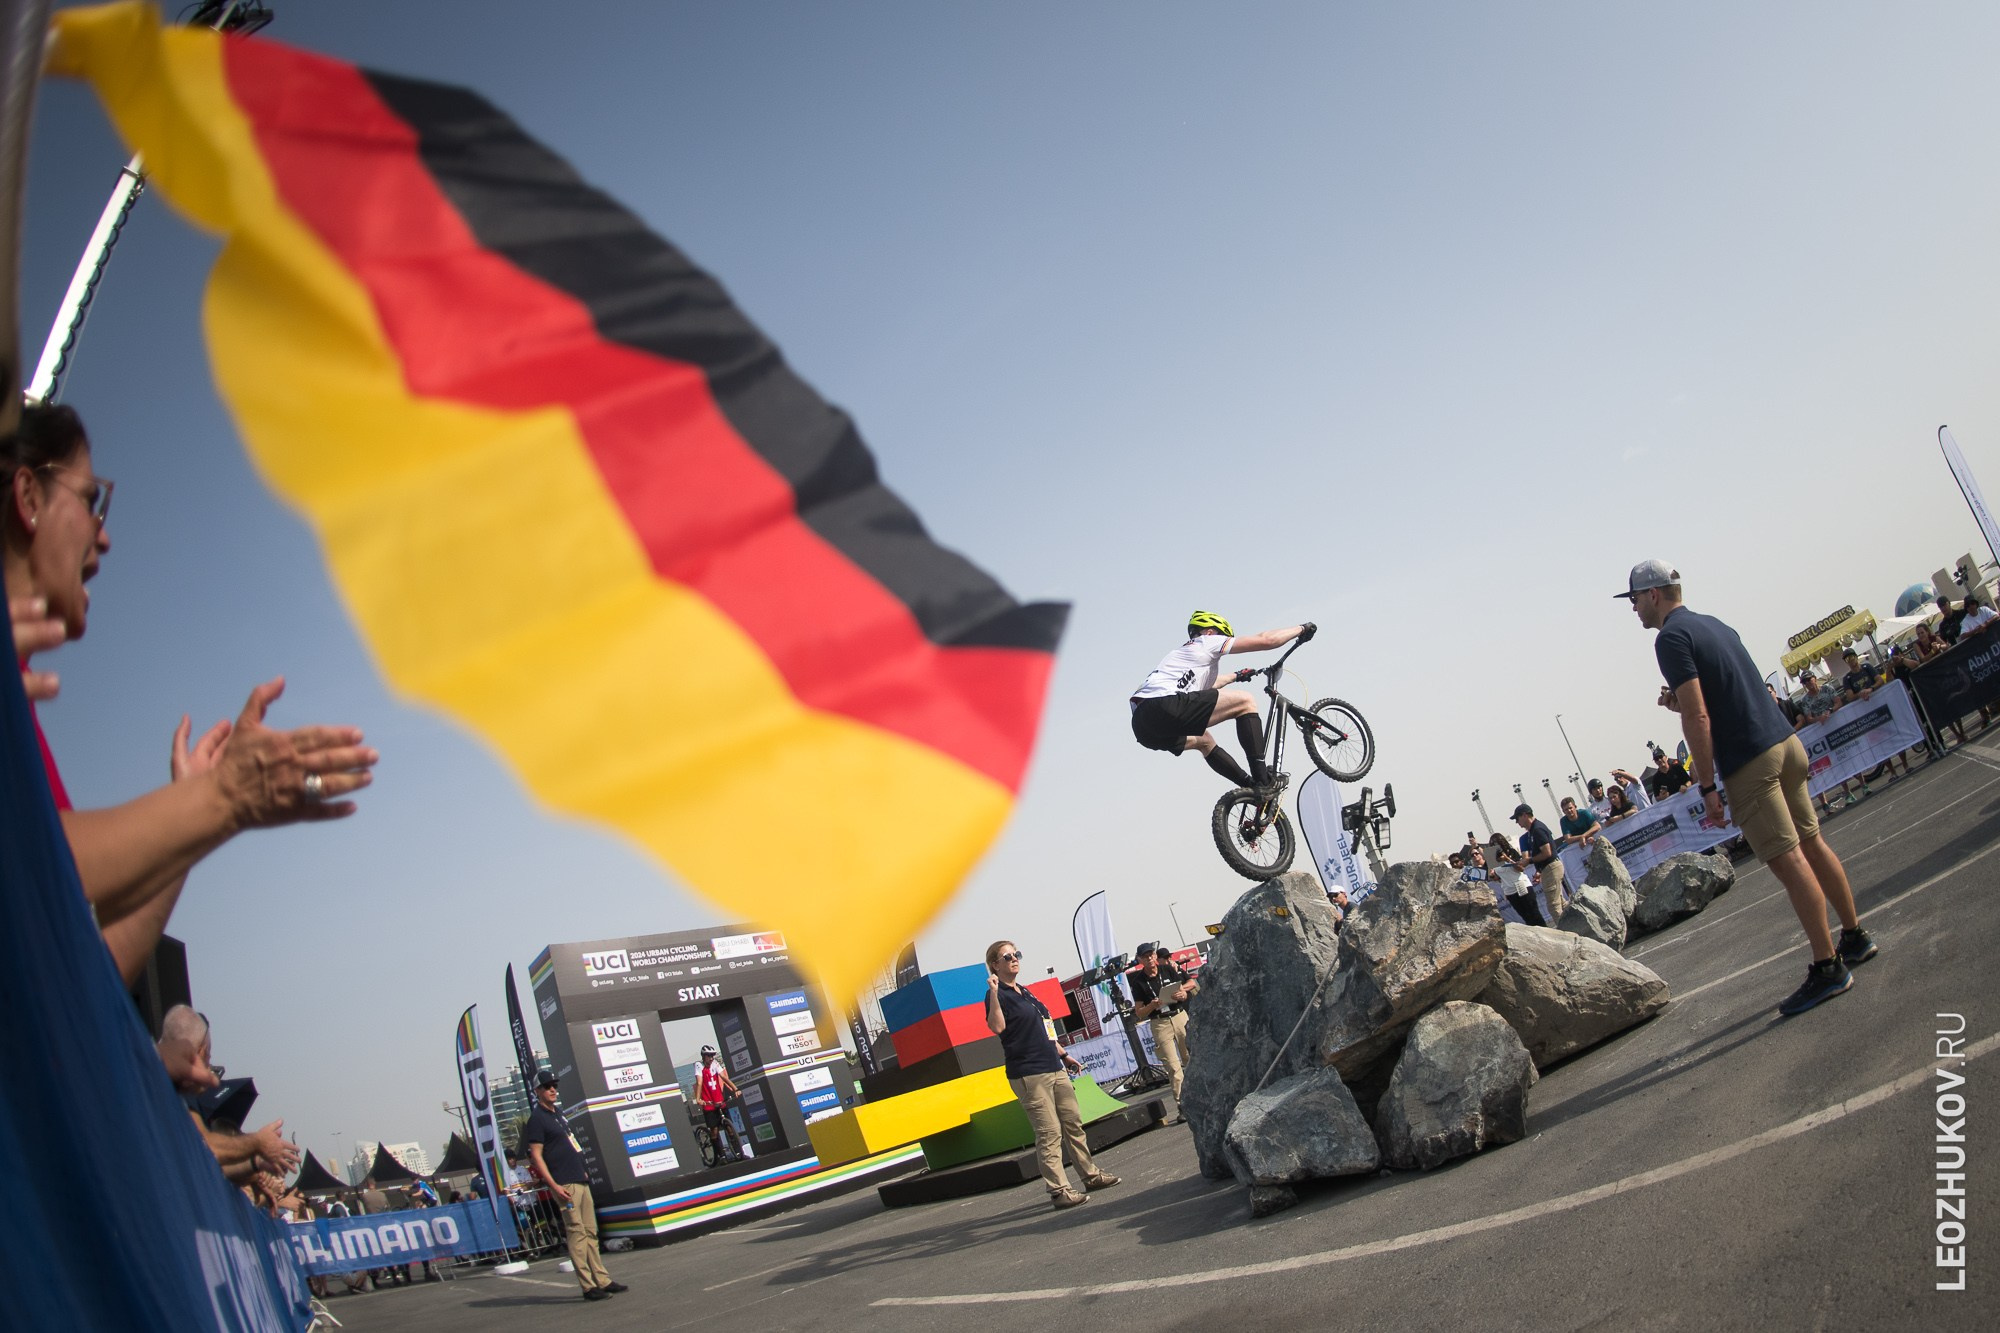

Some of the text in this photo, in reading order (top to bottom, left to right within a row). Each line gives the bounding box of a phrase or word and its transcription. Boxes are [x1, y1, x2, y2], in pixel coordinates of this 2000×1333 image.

[1788, 605, 1855, 649] CAMEL COOKIES
[1968, 651, 1990, 671] Abu
[1972, 661, 2000, 683] Sports
[1337, 833, 1360, 891] BURJEEL
[630, 945, 698, 959] 2024 URBAN CYCLING
[632, 950, 712, 967] WORLD CHAMPIONSHIPS
[592, 954, 626, 971] UCI
[678, 984, 720, 1002] START
[1078, 988, 1092, 1004] PIZZ
[770, 996, 805, 1009] SHIMANO
[603, 1024, 633, 1038] UCI
[787, 1040, 814, 1051] TISSOT
[798, 1056, 814, 1066] UCI
[1081, 1048, 1111, 1064] tadweer
[1086, 1060, 1107, 1073] group
[614, 1073, 644, 1085] TISSOT
[463, 1057, 495, 1153] UCI
[626, 1092, 643, 1102] UCI
[801, 1092, 836, 1107] SHIMANO
[627, 1132, 668, 1148] SHIMANO
